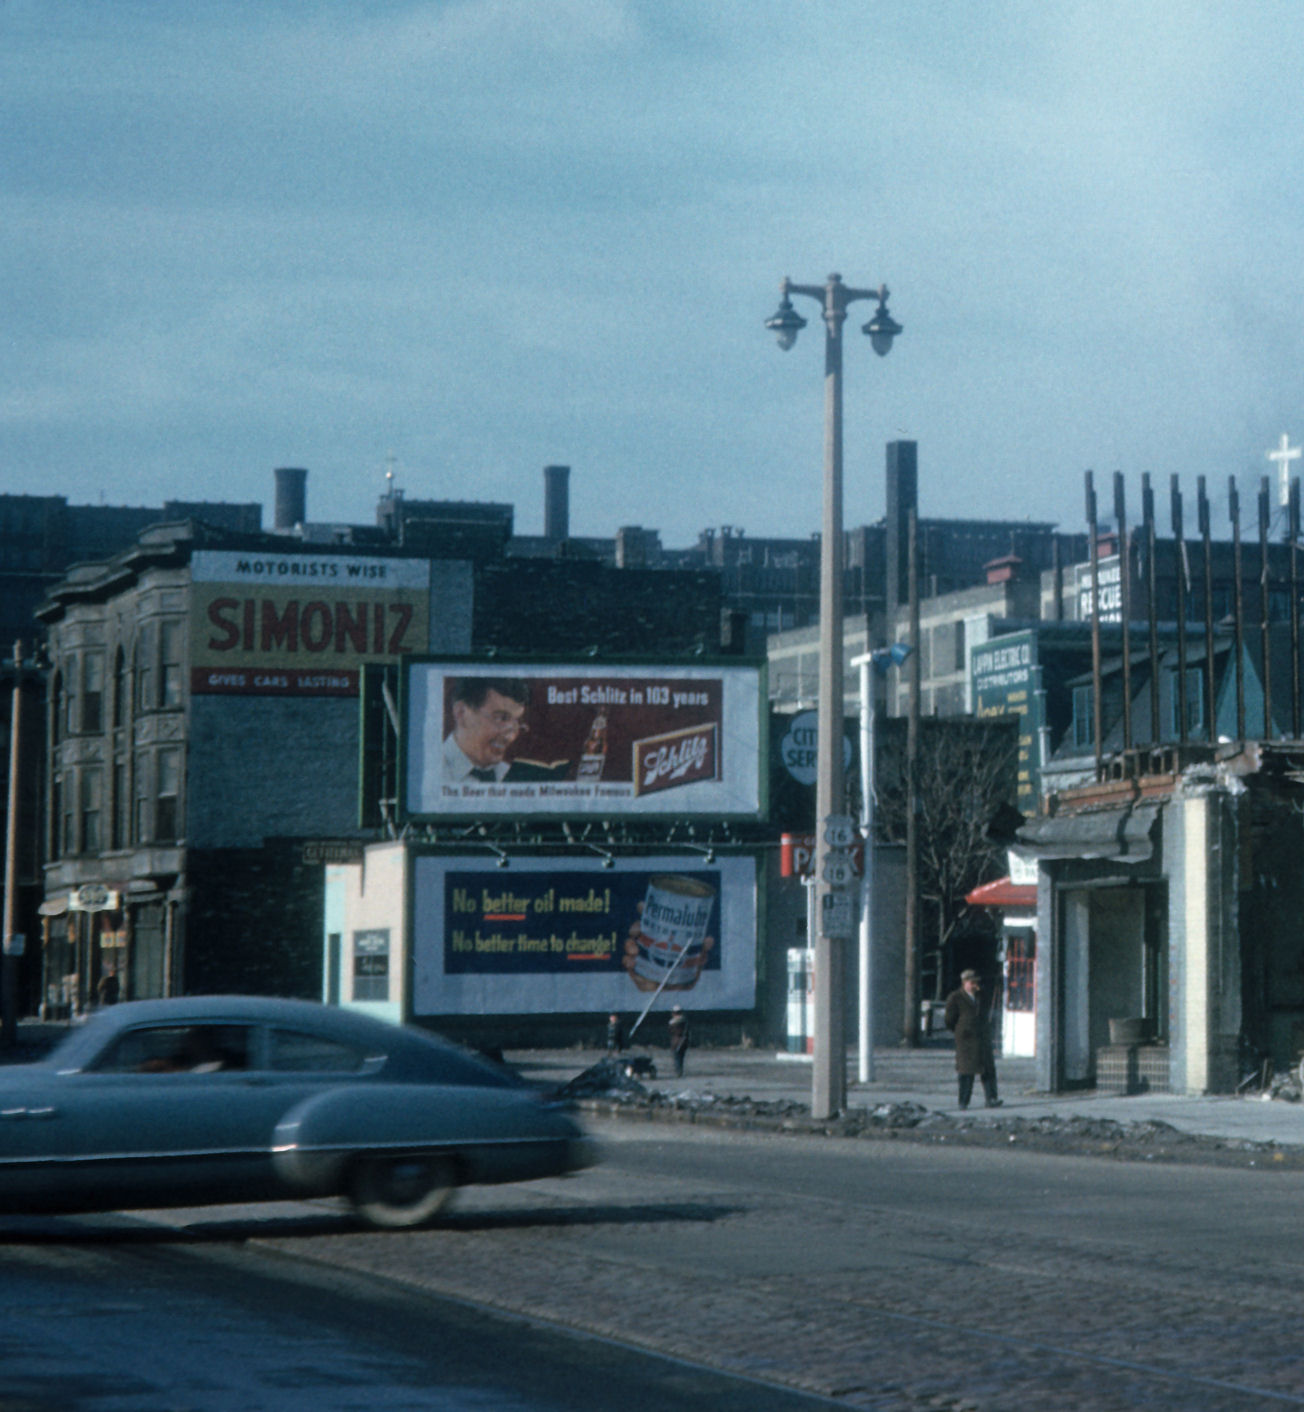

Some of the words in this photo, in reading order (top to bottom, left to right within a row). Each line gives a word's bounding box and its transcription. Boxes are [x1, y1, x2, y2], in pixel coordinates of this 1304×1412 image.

[236, 560, 338, 577] MOTORISTS
[346, 564, 387, 579] WISE
[207, 598, 414, 654] SIMONIZ
[208, 674, 246, 686] GIVES
[254, 675, 288, 688] CARS
[298, 676, 350, 689] LASTING
[547, 686, 577, 705] Best
[581, 686, 627, 705] Schlitz
[630, 688, 643, 705] in
[673, 690, 709, 709] years
[644, 735, 708, 786] Schlitz
[442, 786, 459, 797] The
[462, 786, 486, 798] Beer
[488, 786, 507, 797] that
[510, 786, 536, 797] made
[539, 785, 591, 799] Milwaukee
[594, 786, 631, 798] Famous
[829, 828, 847, 844] 16
[453, 888, 476, 912] No
[482, 888, 530, 912] better
[534, 888, 554, 912] oil
[559, 888, 611, 912] made!
[452, 931, 473, 951] No
[476, 930, 515, 951] better
[517, 931, 548, 951] time
[550, 934, 562, 951] to
[566, 931, 617, 956] change!
